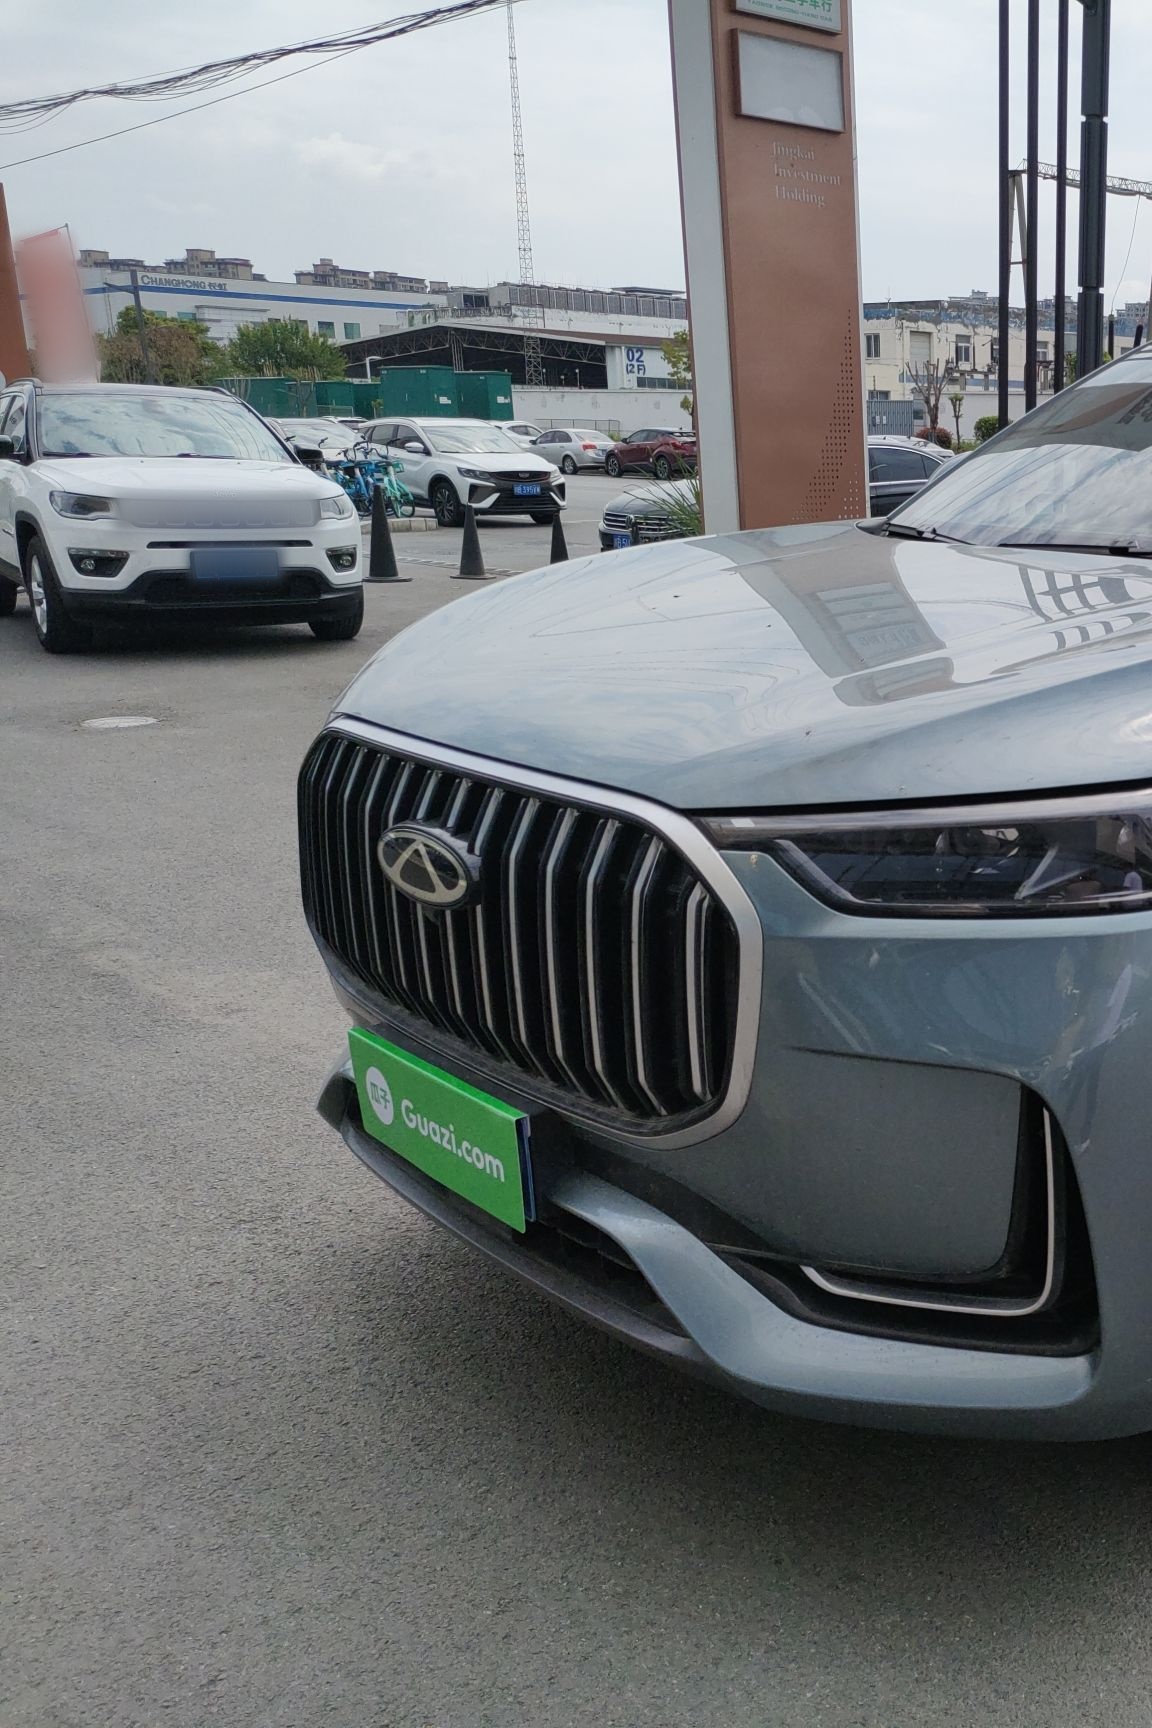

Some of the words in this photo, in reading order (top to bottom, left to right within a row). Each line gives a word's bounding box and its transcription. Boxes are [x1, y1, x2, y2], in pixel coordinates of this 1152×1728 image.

[771, 141, 815, 161] Jingkai
[774, 163, 841, 186] Investment
[775, 185, 825, 208] Holding
[141, 275, 206, 289] CHANGHONG
[626, 348, 644, 363] 02
[400, 1099, 506, 1183] Guazi.com
